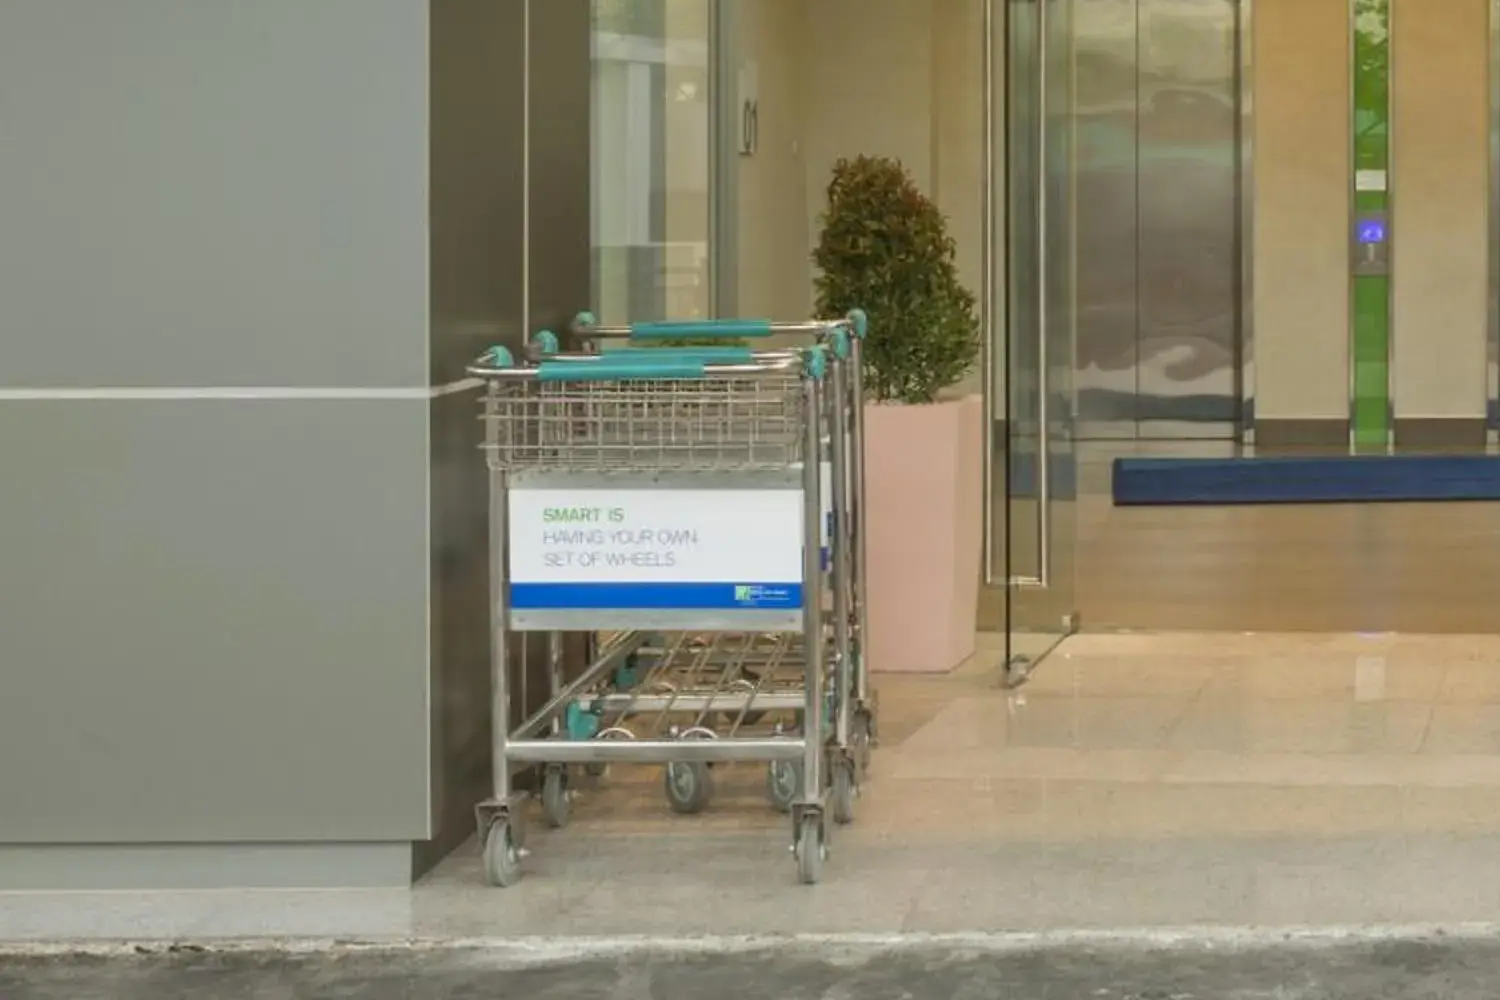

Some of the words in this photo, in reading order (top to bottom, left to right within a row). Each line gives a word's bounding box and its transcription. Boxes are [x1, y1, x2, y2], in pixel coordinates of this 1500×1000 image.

[543, 507, 601, 523] SMART
[608, 507, 625, 523] IS
[543, 529, 605, 545] HAVING
[610, 529, 653, 545] YOUR
[657, 529, 699, 545] OWN
[543, 551, 574, 567] SET
[577, 551, 601, 567] OF
[605, 551, 676, 567] WHEELS
